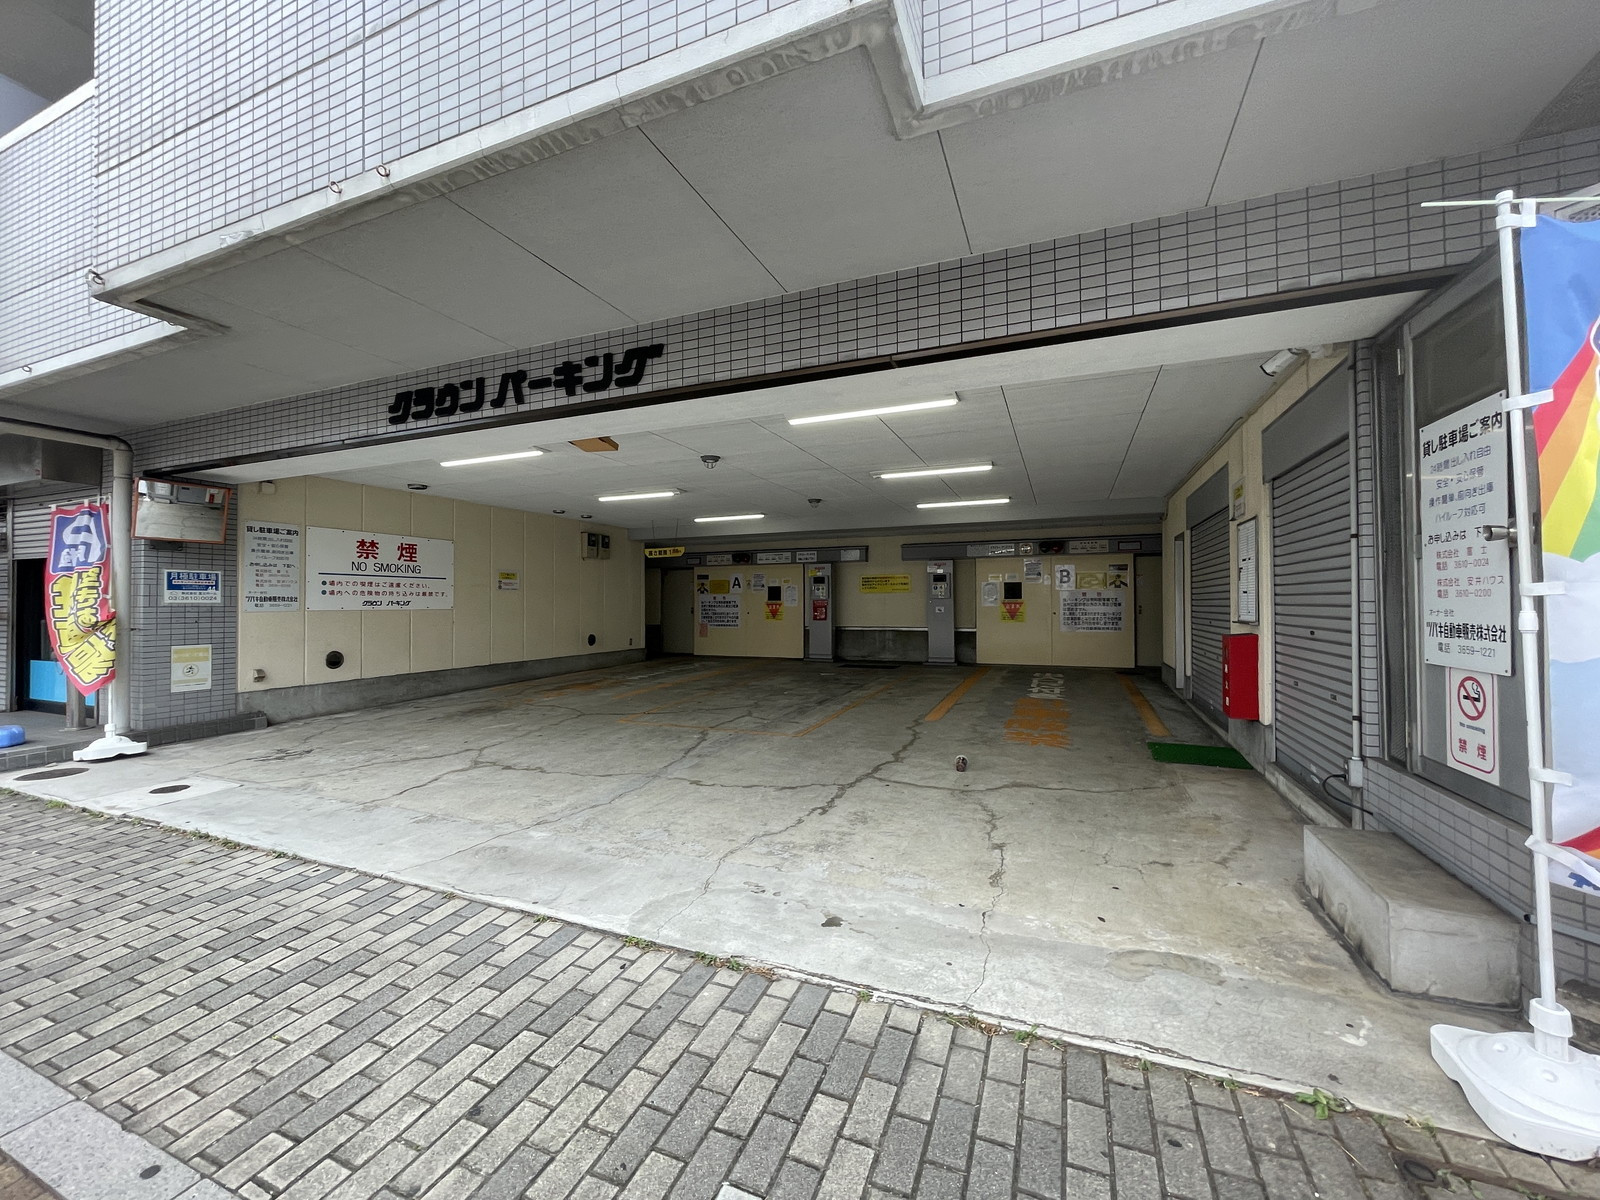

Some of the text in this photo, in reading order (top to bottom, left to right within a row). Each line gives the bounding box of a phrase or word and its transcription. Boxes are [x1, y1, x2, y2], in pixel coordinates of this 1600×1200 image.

[388, 343, 665, 425] クラウン パーキング
[1422, 411, 1503, 459] 貸し駐車場ご案内
[246, 525, 299, 536] 貸し駐車場ご案内
[1427, 530, 1467, 545] お申し込みは
[356, 538, 418, 563] 禁煙
[1436, 549, 1459, 559] 株式会社
[351, 561, 422, 574] NO SMOKING
[1436, 561, 1448, 571] 電話
[732, 576, 742, 589] A
[1059, 568, 1071, 584] B
[1437, 575, 1505, 587] 株式会社 安井ハウス
[1437, 589, 1449, 599] 電話
[1426, 622, 1507, 643] ツバキ自動車販売株式会社
[1438, 642, 1451, 654] 電話
